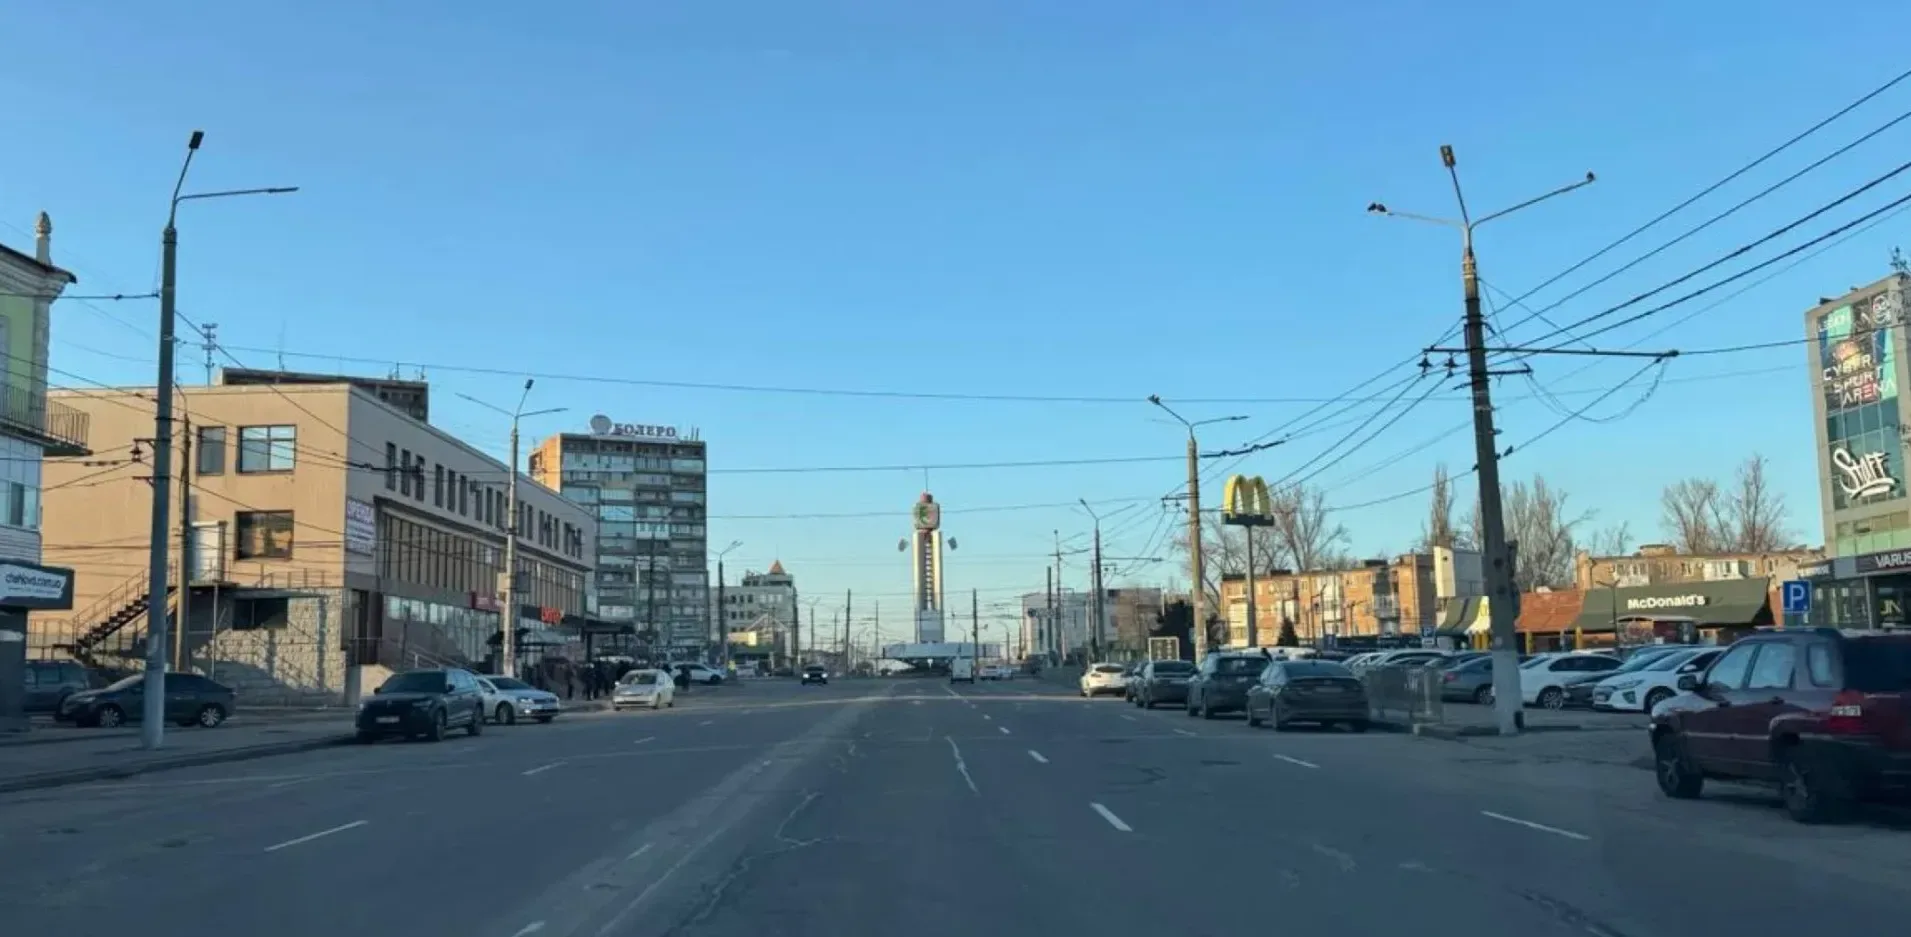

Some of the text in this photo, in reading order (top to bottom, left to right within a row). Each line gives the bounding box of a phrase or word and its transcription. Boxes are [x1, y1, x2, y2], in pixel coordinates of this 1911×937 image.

[1823, 354, 1873, 381] CYBER
[1833, 366, 1884, 394] SPORT
[1842, 377, 1899, 406] ARENA
[612, 423, 676, 437] БОЛЕРО
[1627, 594, 1705, 610] McDonald's
[1789, 584, 1805, 610] P
